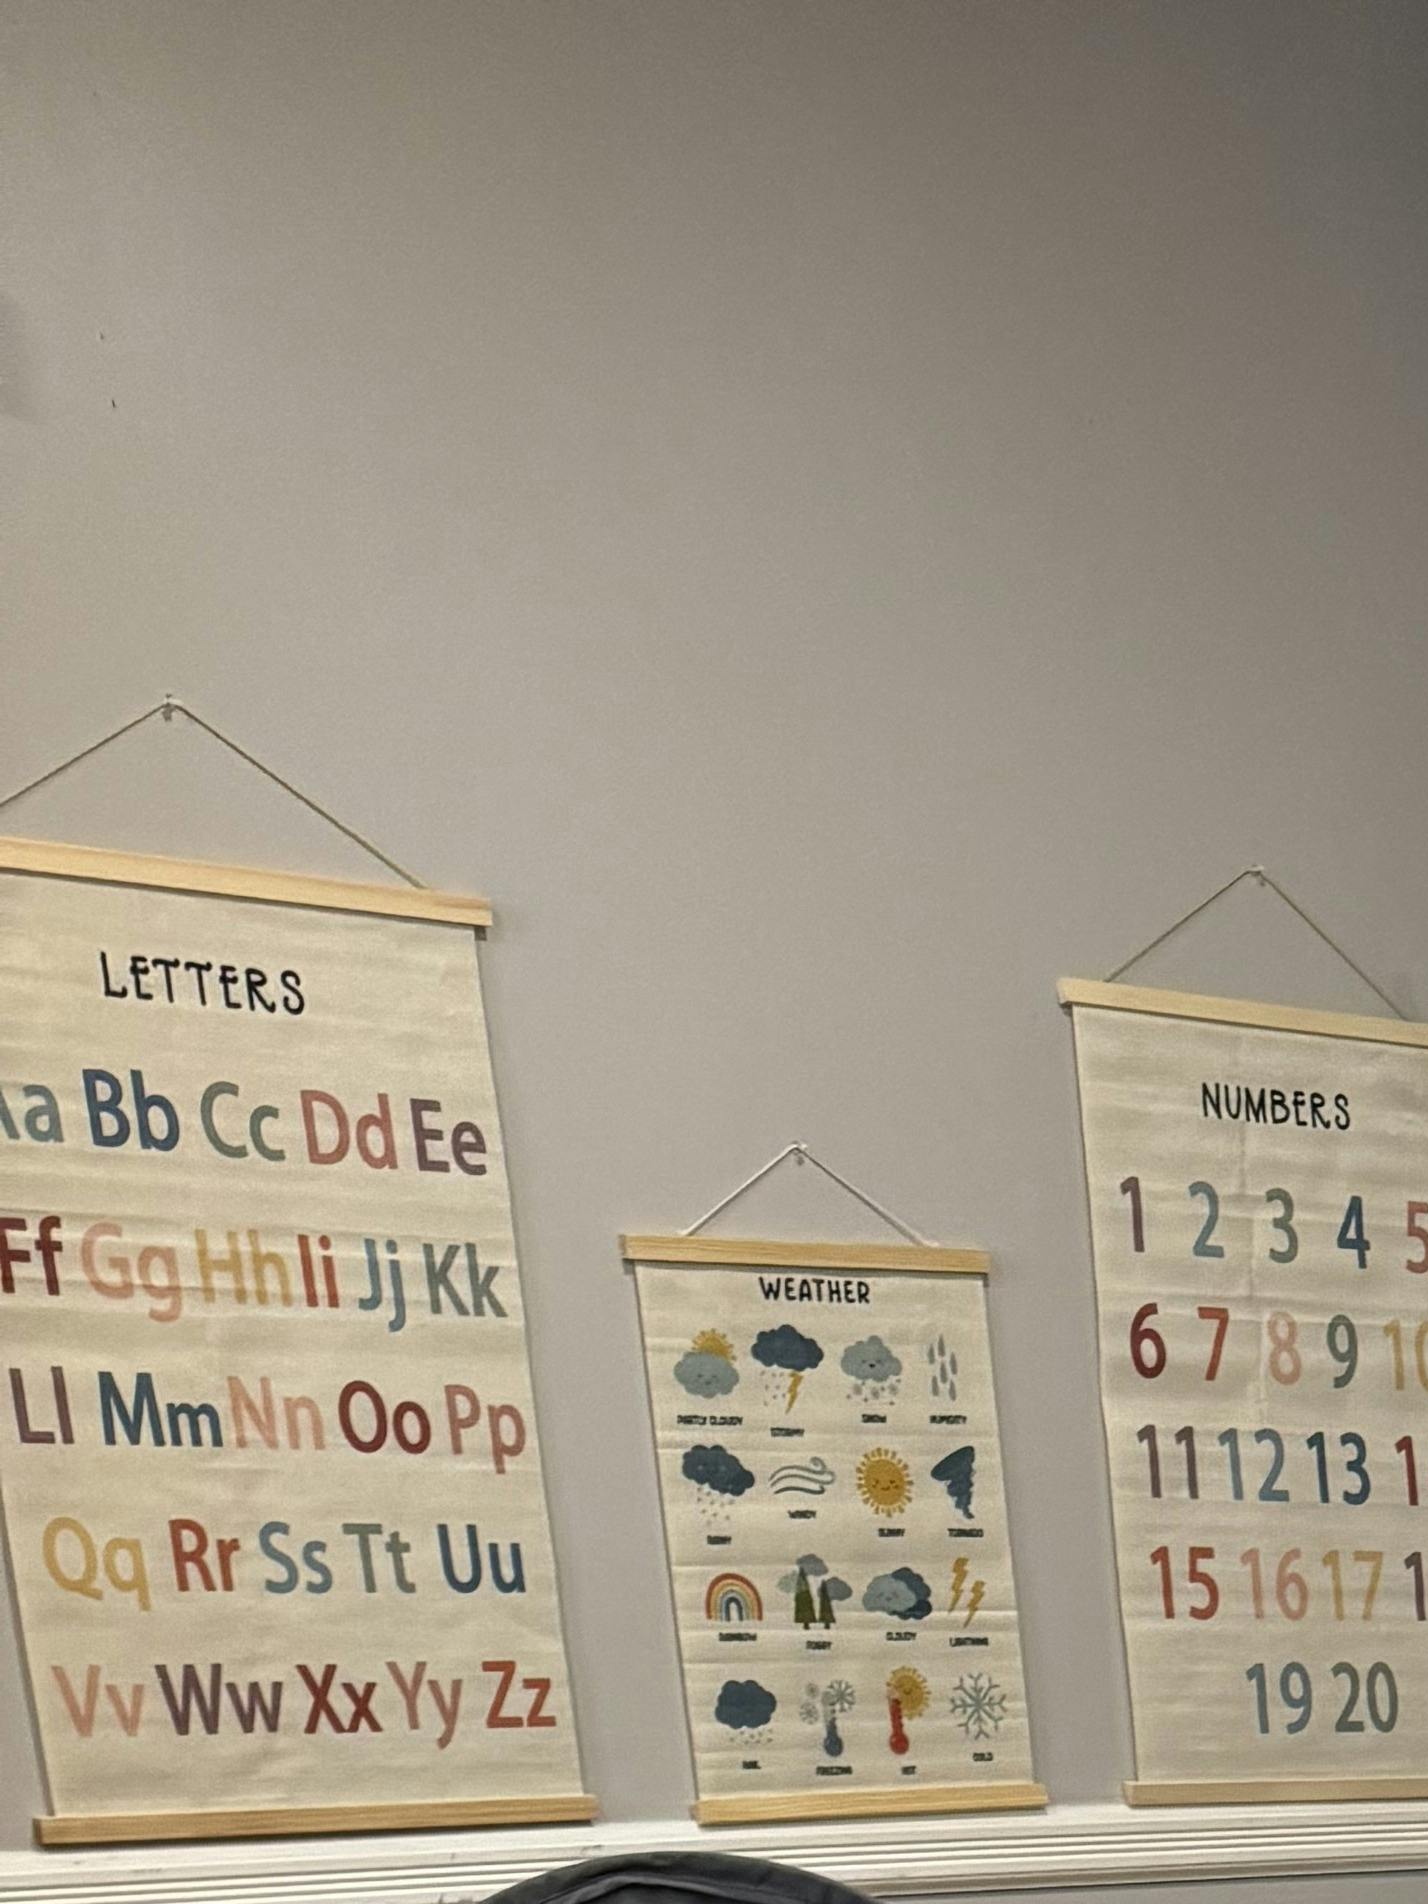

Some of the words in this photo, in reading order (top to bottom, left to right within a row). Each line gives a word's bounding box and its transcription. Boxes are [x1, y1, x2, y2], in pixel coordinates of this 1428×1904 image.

[100, 952, 304, 1015] LETTERS
[83, 1069, 179, 1151] Bb
[201, 1081, 285, 1161] Cc
[300, 1090, 398, 1169] Dd
[410, 1098, 486, 1175] Ee
[1202, 1083, 1350, 1130] NUMBERS
[1120, 1177, 1144, 1252] 1
[1189, 1181, 1224, 1258] 2
[1266, 1188, 1298, 1263] 3
[1337, 1196, 1370, 1269] 4
[0, 1216, 63, 1296] Ff
[81, 1222, 188, 1322] Gg
[192, 1228, 293, 1307] Hh
[298, 1234, 339, 1308] Ii
[359, 1238, 406, 1332] Jj
[423, 1242, 507, 1317] Kk
[759, 1277, 869, 1303] WEATHER
[1131, 1303, 1166, 1379] 6
[1198, 1307, 1229, 1381] 7
[1268, 1312, 1305, 1386] 8
[1327, 1315, 1357, 1388] 9
[10, 1365, 74, 1445] Ll
[98, 1372, 223, 1447] Mm
[227, 1376, 326, 1450] Nn
[338, 1381, 431, 1454] Oo
[445, 1385, 526, 1474] Pp
[1137, 1425, 1198, 1499] 11
[1218, 1428, 1290, 1502] 12
[1307, 1432, 1371, 1505] 13
[43, 1517, 151, 1611] Qq
[169, 1519, 240, 1592] Rr
[259, 1521, 332, 1594] Ss
[342, 1523, 416, 1593] Tt
[437, 1524, 526, 1593] Uu
[1150, 1546, 1219, 1620] 15
[1241, 1548, 1309, 1621] 16
[1322, 1550, 1384, 1621] 17
[51, 1665, 144, 1737] Vv
[155, 1663, 283, 1735] Ww
[296, 1664, 382, 1734] Xx
[386, 1661, 462, 1750] Yy
[482, 1661, 556, 1728] Zz
[1246, 1662, 1312, 1734] 19
[1332, 1662, 1398, 1733] 20
